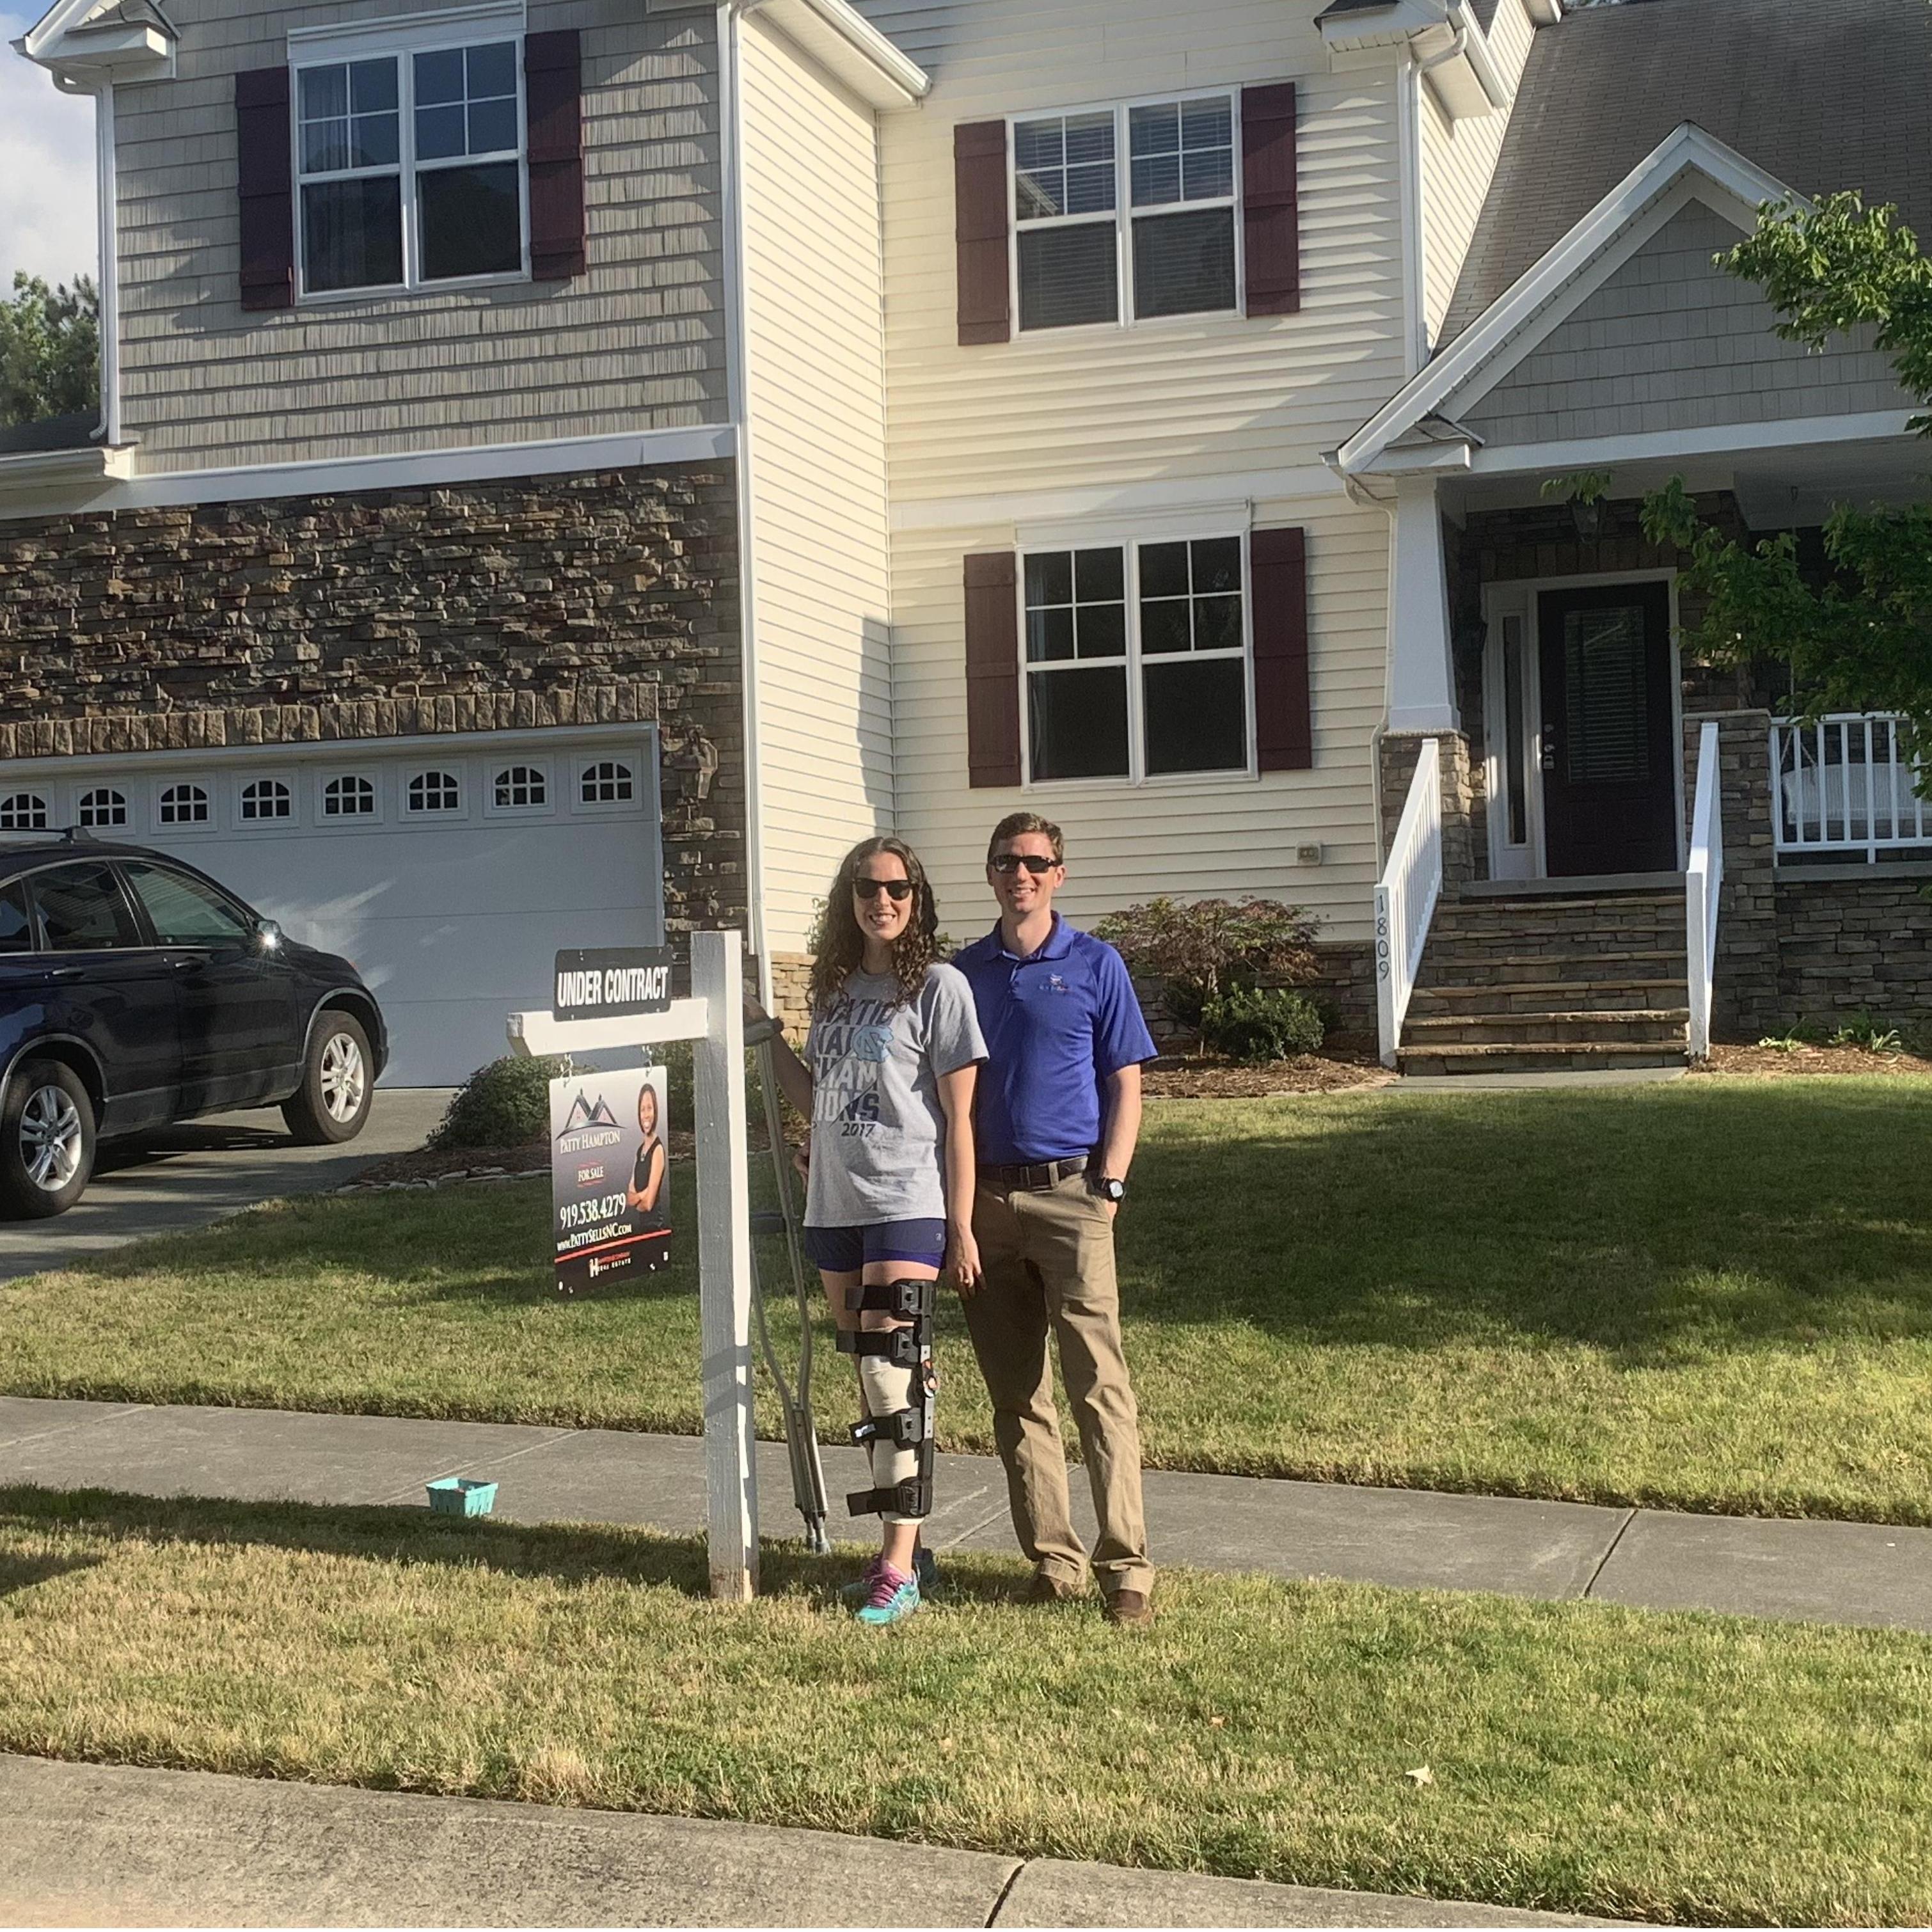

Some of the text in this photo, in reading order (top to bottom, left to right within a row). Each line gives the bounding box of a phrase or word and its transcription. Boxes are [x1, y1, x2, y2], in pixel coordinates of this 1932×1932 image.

[1377, 894, 1390, 983] 1809
[558, 966, 669, 1008] UNDER CONTRACT
[560, 1130, 621, 1153] PATTY HAMPTON
[841, 1123, 876, 1137] 2017
[578, 1166, 604, 1182] FOR SALE
[560, 1192, 626, 1230] 919.538.4279
